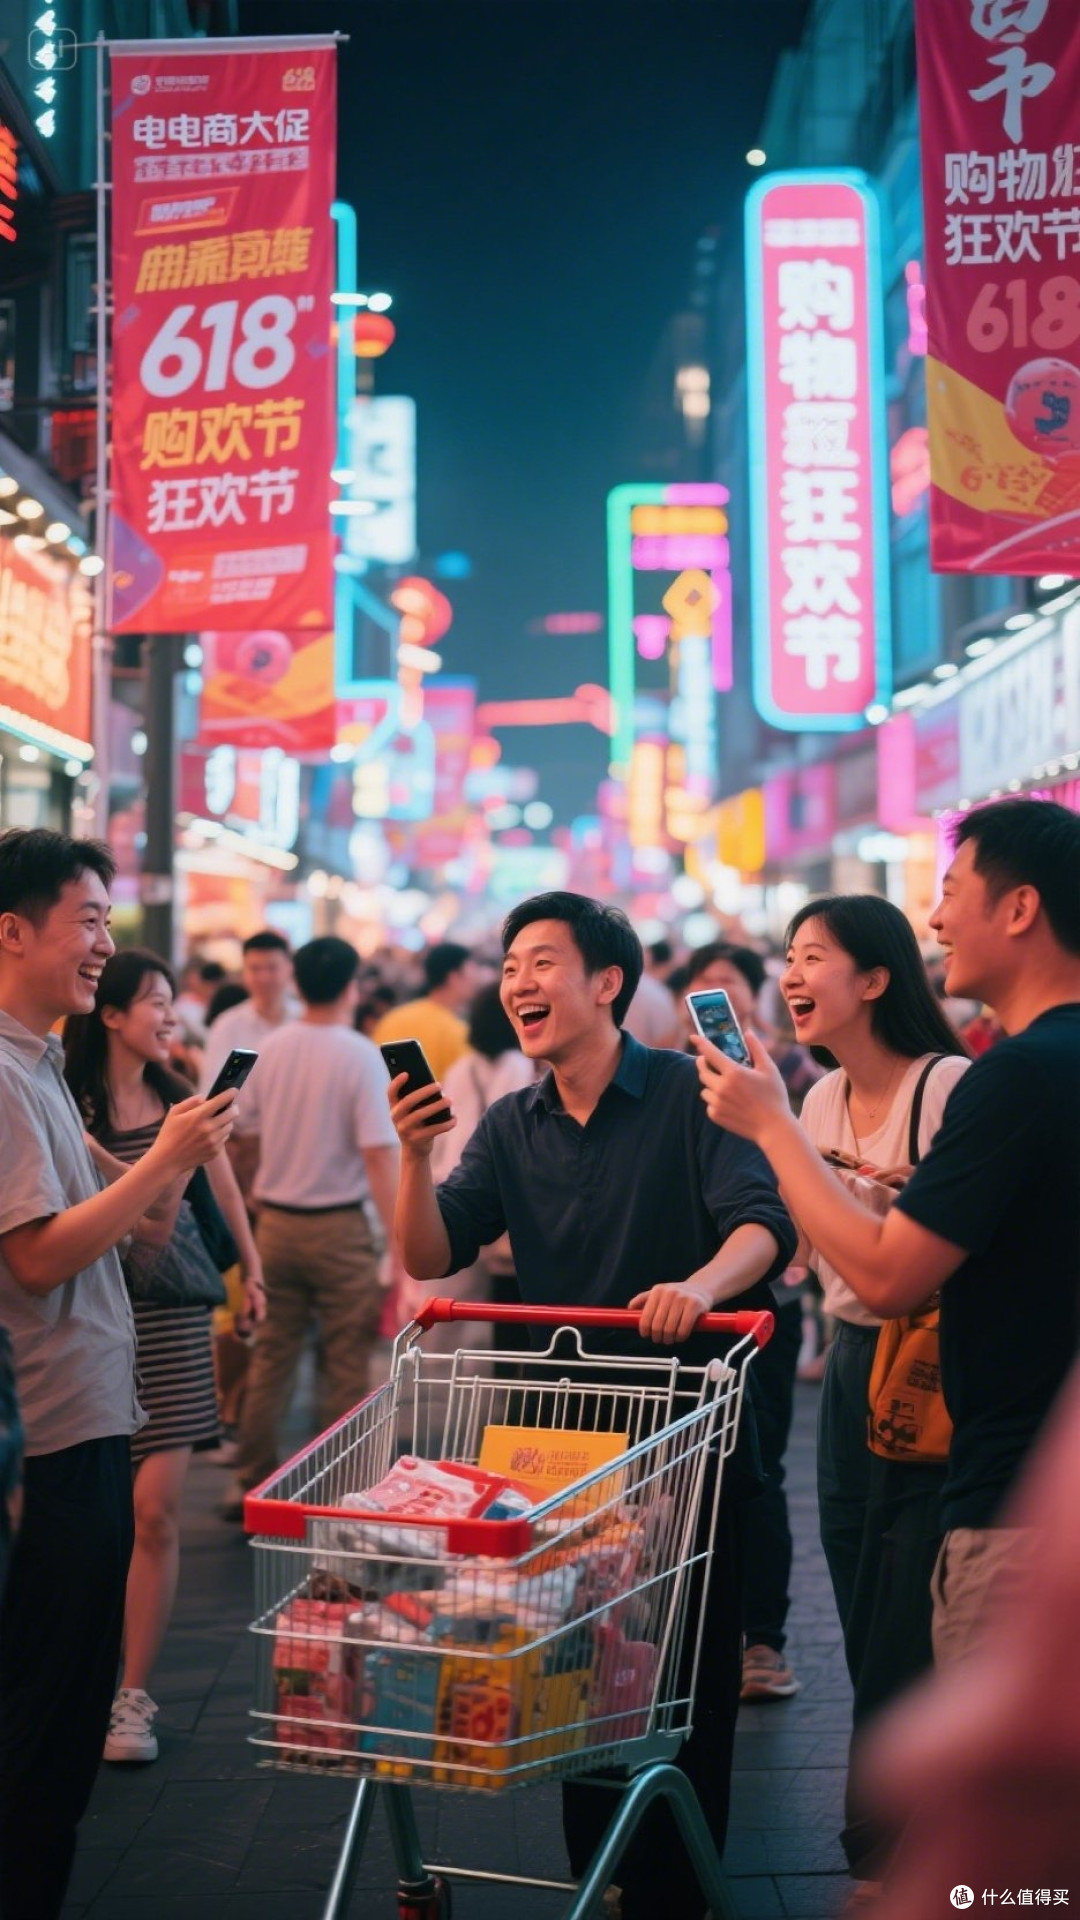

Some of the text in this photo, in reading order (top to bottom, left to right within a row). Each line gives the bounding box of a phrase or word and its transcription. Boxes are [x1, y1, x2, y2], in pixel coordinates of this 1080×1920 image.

[133, 109, 310, 149] 电电商大促
[944, 206, 1080, 266] 狂欢节
[966, 275, 1080, 353] 618
[140, 397, 305, 471] 购欢节
[147, 467, 299, 534] 狂欢节
